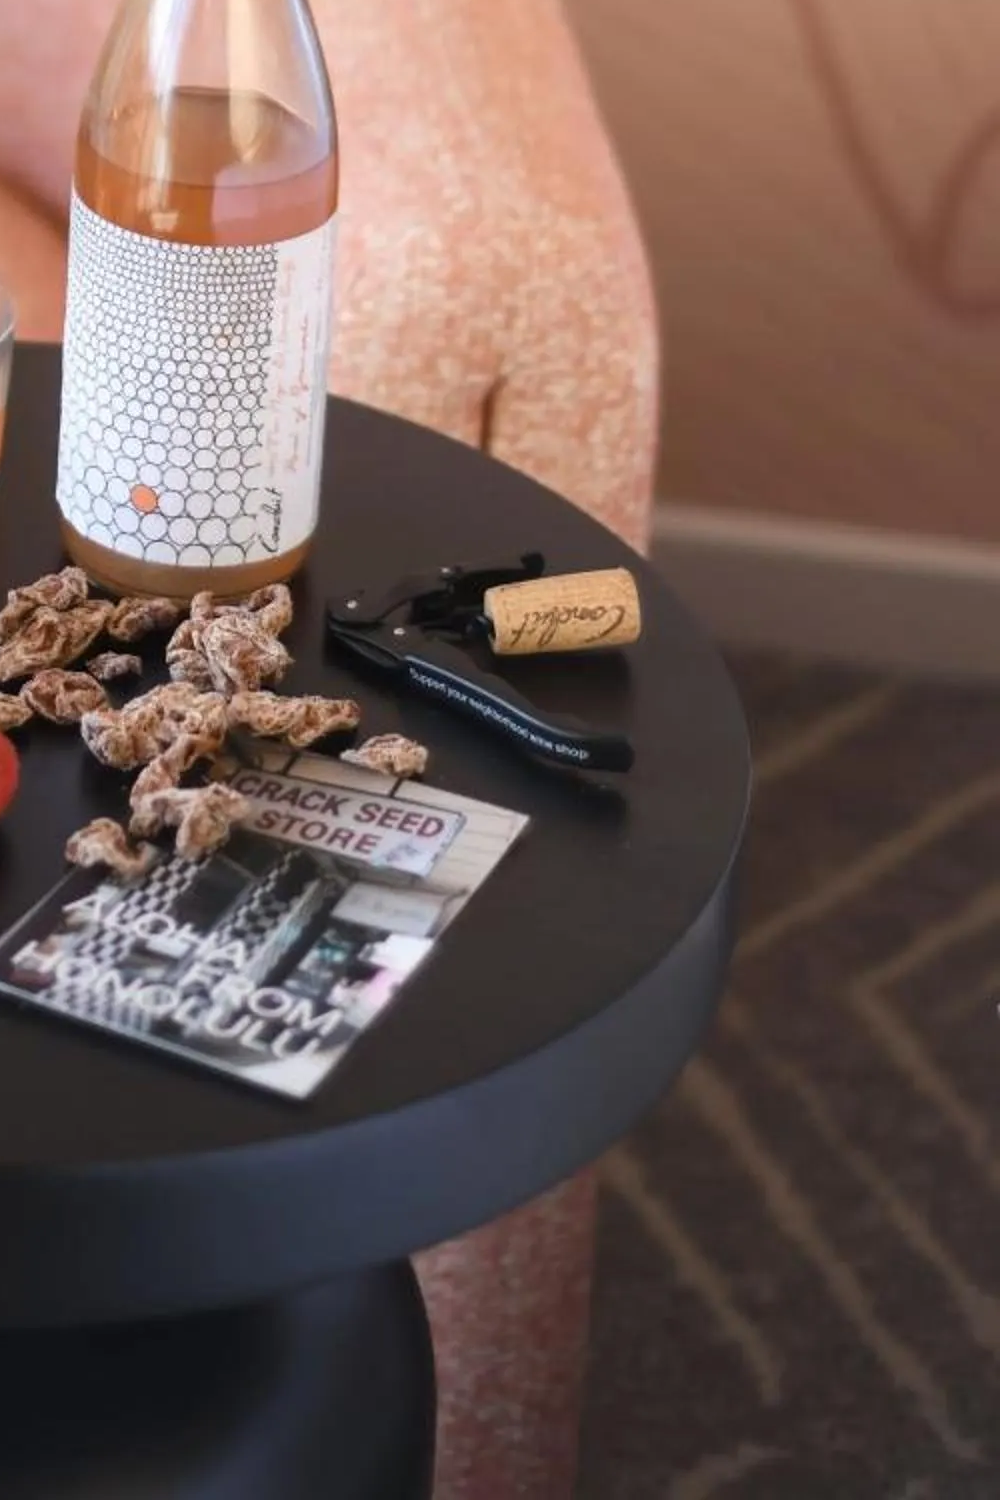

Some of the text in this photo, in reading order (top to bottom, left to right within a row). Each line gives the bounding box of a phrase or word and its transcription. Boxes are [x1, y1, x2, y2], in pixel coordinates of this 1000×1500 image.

[554, 743, 590, 761] shop
[233, 773, 445, 841] CRACK SEED
[253, 810, 381, 854] STORE
[62, 890, 246, 970] ALOHA
[10, 939, 321, 1059] HONOLULU
[175, 961, 344, 1037] FROM
